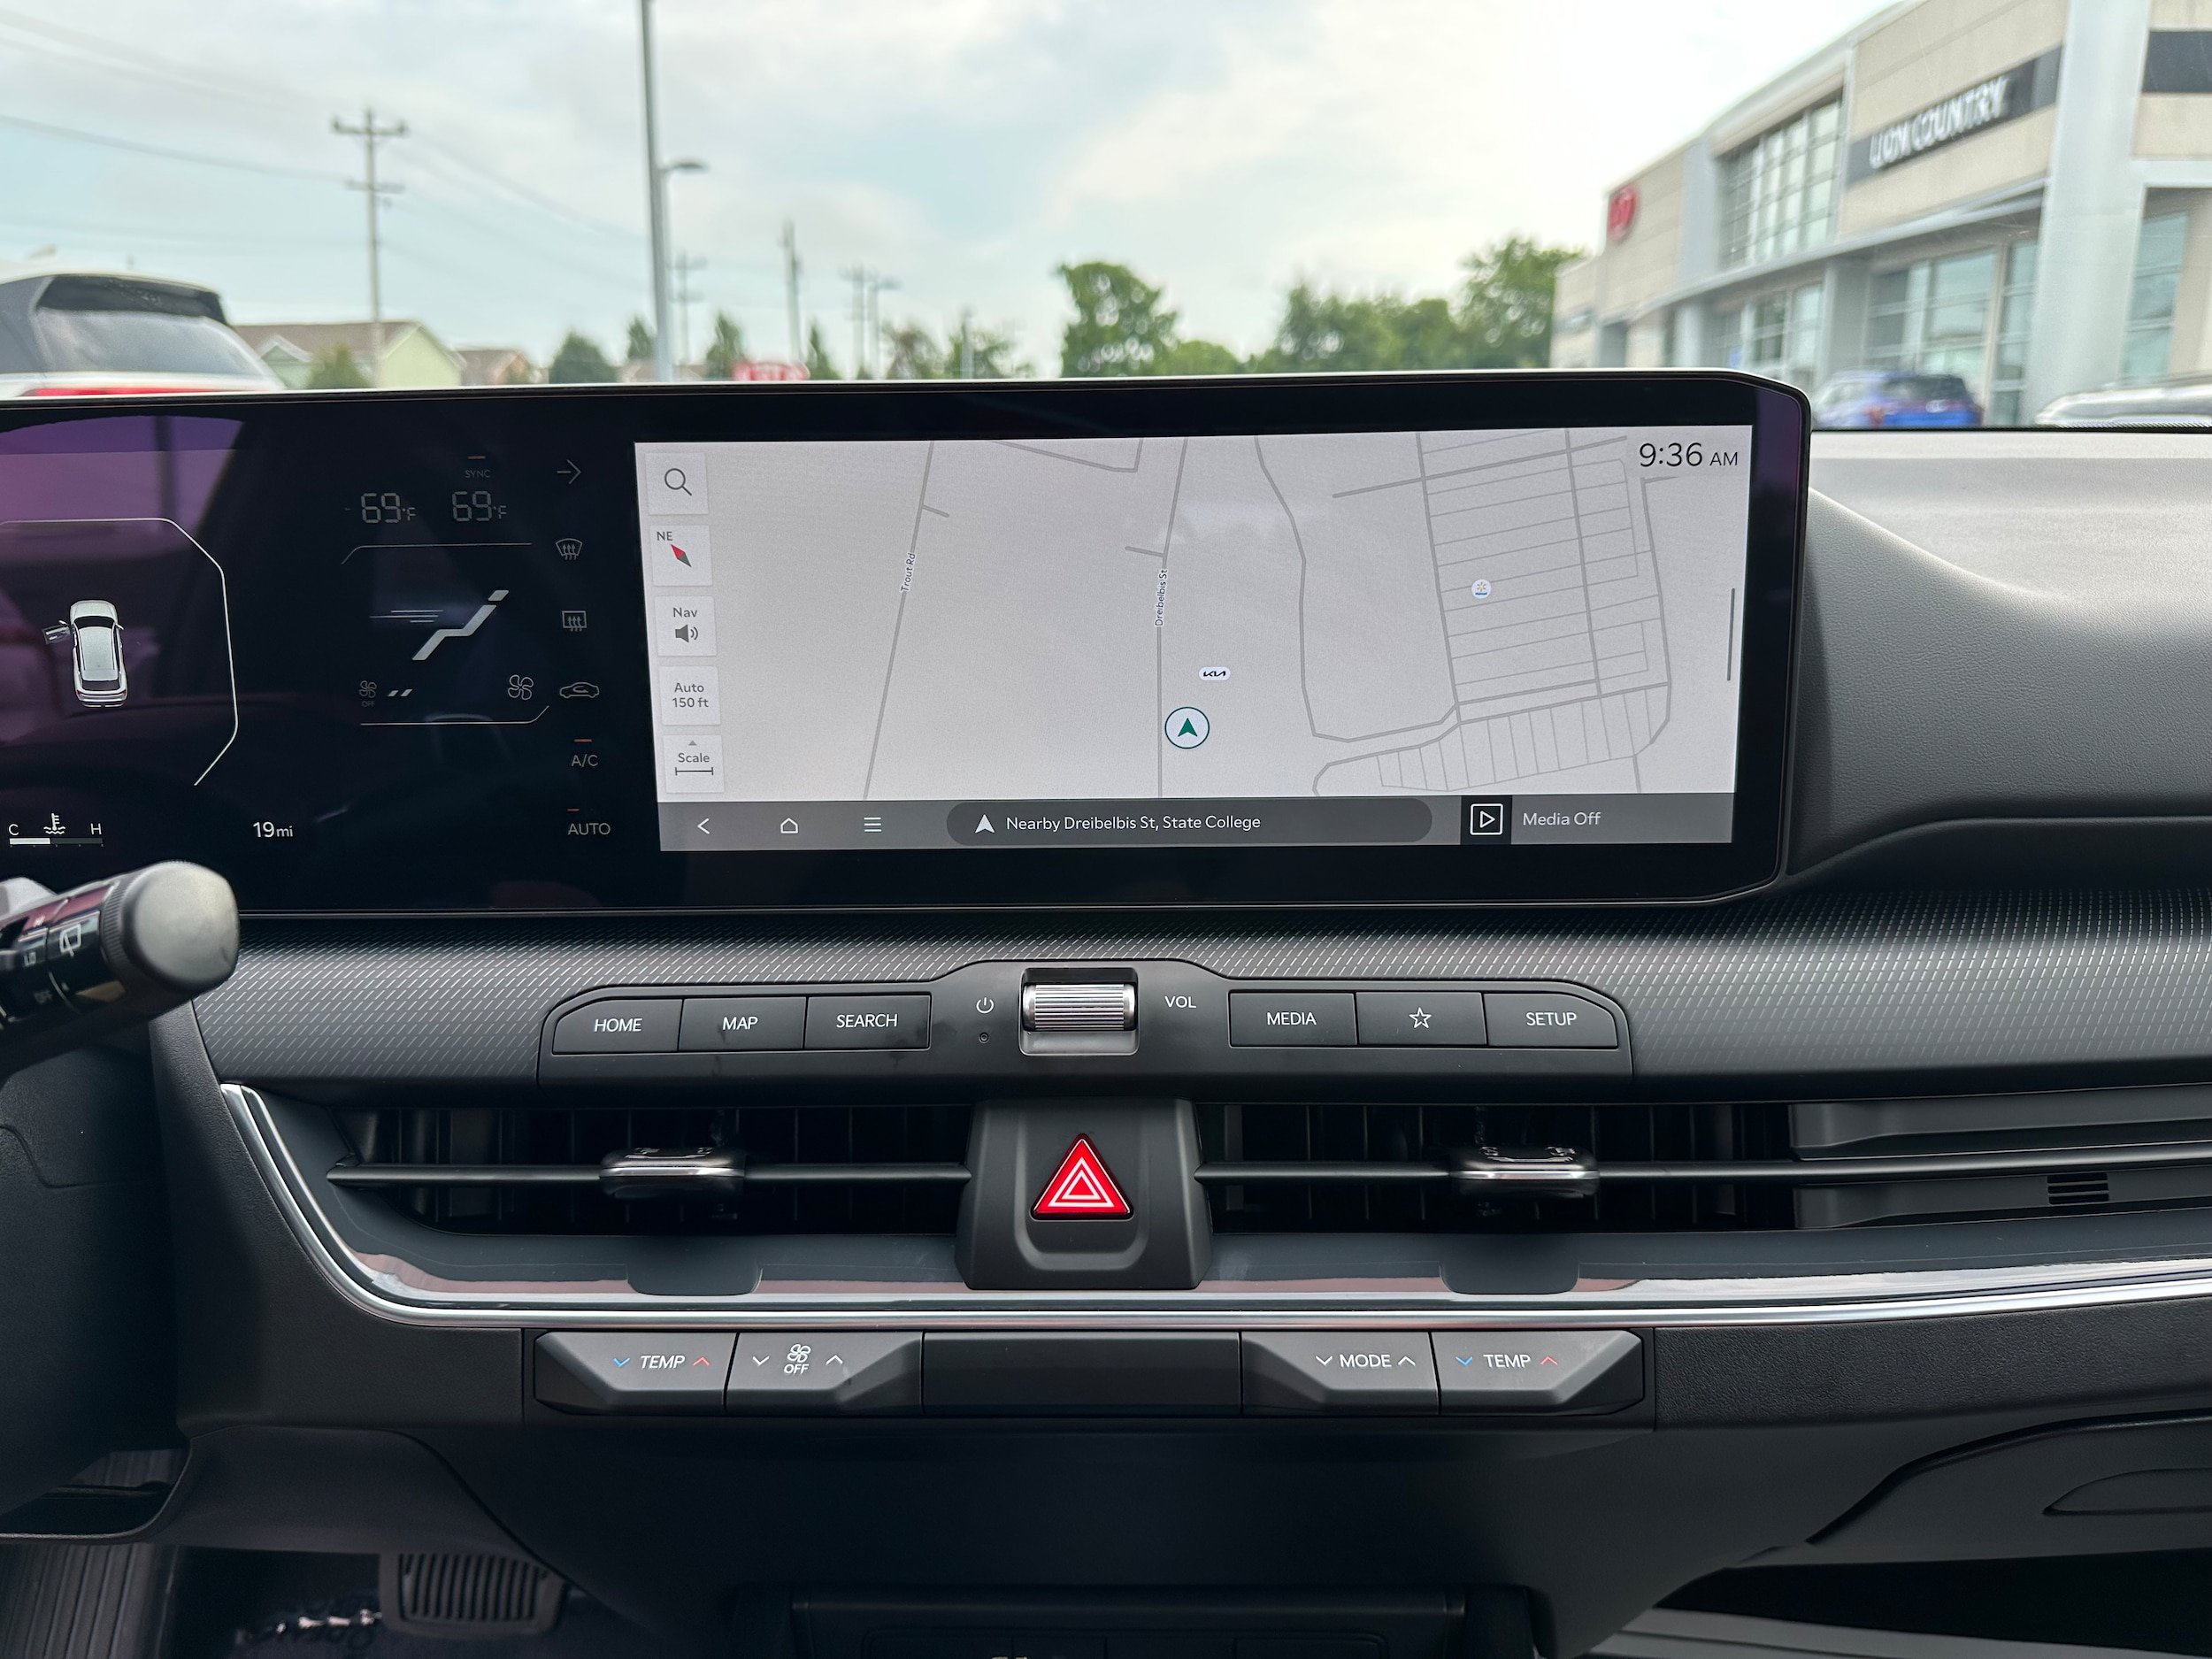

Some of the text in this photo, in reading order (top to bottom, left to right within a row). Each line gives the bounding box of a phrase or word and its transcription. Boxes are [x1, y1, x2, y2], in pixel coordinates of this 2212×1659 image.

[1640, 442, 1738, 467] 9:36 AM
[465, 469, 490, 479] SYNC
[657, 532, 673, 541] NE
[900, 552, 916, 591] Trout Rd
[1155, 569, 1167, 626] Dreibelbis St
[672, 607, 697, 618] Nav
[674, 682, 704, 693] Auto
[672, 697, 709, 708] 150 ft
[571, 755, 599, 767] A/C
[678, 752, 710, 764] Scale
[1006, 814, 1261, 832] Nearby Dreibelbis St, State College
[1523, 811, 1601, 826] Media Off
[8, 824, 19, 835] C
[90, 823, 102, 834] H
[568, 822, 611, 835] AUTO
[1164, 995, 1196, 1009] VOL
[594, 1018, 642, 1033] HOME
[722, 1017, 758, 1031] MAP
[836, 1014, 898, 1029] SEARCH
[1267, 1012, 1317, 1026] MEDIA
[1525, 1012, 1577, 1026] SETUP
[641, 1355, 686, 1369] TEMP
[1340, 1354, 1392, 1368] MODE
[1483, 1354, 1532, 1368] TEMP
[784, 1363, 809, 1374] OFF
